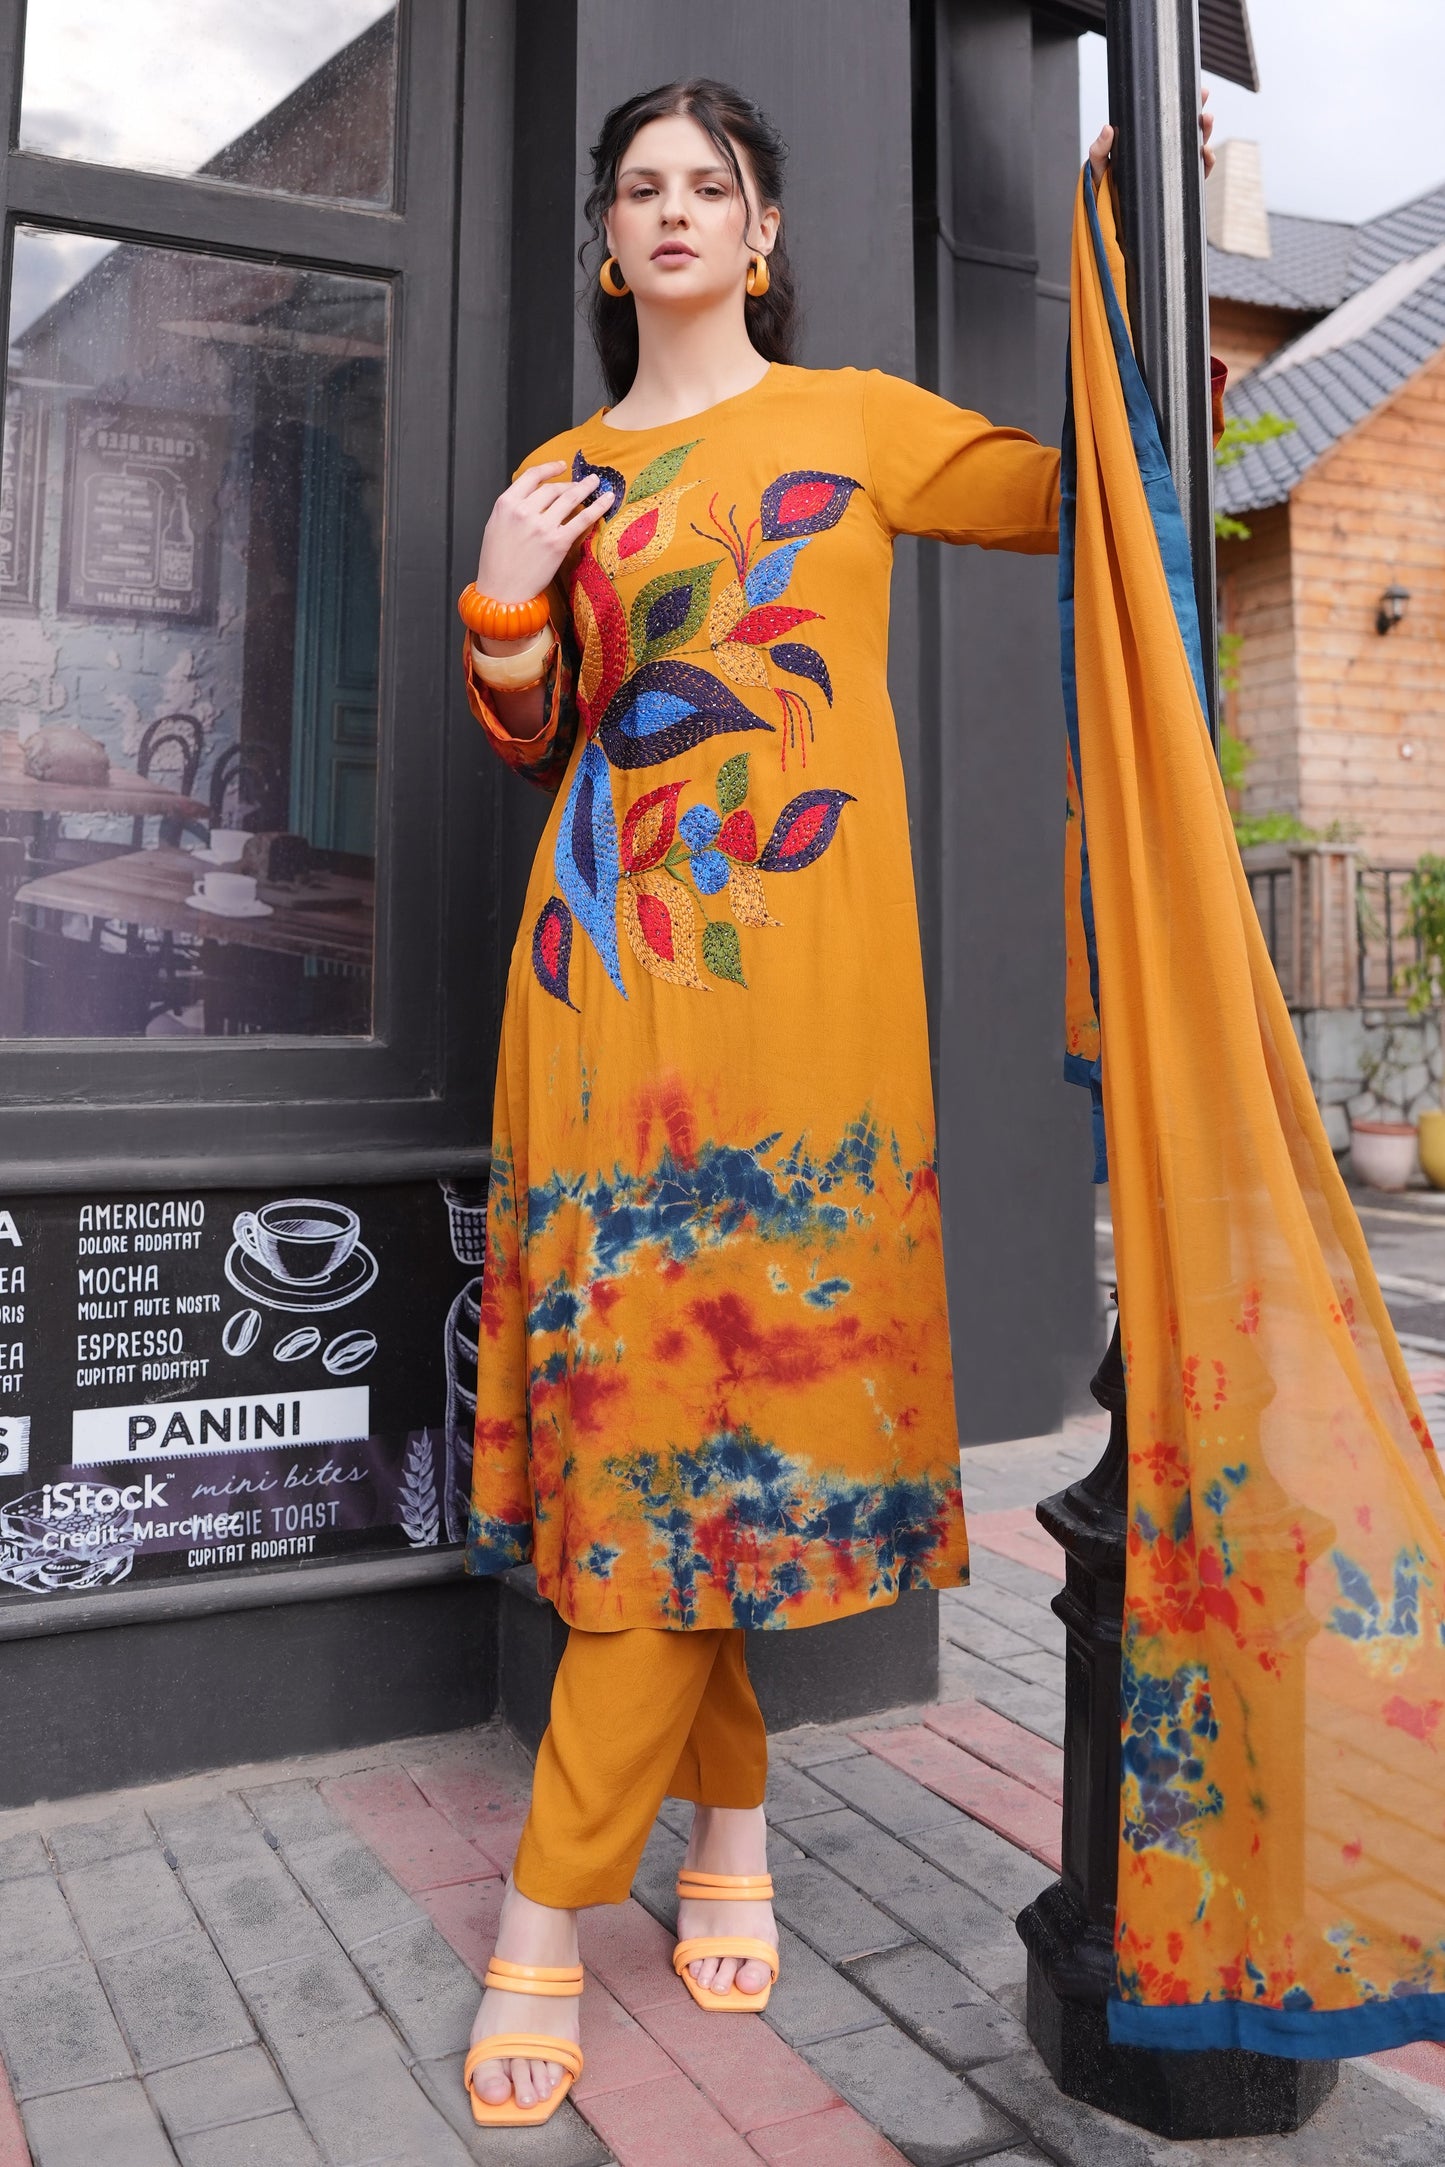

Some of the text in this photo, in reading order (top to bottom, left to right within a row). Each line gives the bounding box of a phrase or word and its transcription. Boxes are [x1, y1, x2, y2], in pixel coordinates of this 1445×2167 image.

[79, 1199, 205, 1232] AMERICANO
[78, 1231, 203, 1256] DOLORE ADDATAT
[78, 1264, 159, 1296] MOCHA
[77, 1294, 222, 1321] MOLLIT AUTE NOSTR
[77, 1327, 184, 1362] ESPRESSO
[76, 1359, 210, 1388] CUPITAT ADDATAT
[128, 1400, 300, 1451] PANINI
[191, 1459, 369, 1499] mini bites
[270, 1501, 340, 1533] TOAST
[187, 1535, 316, 1568] CUPITAT ADDATAT
